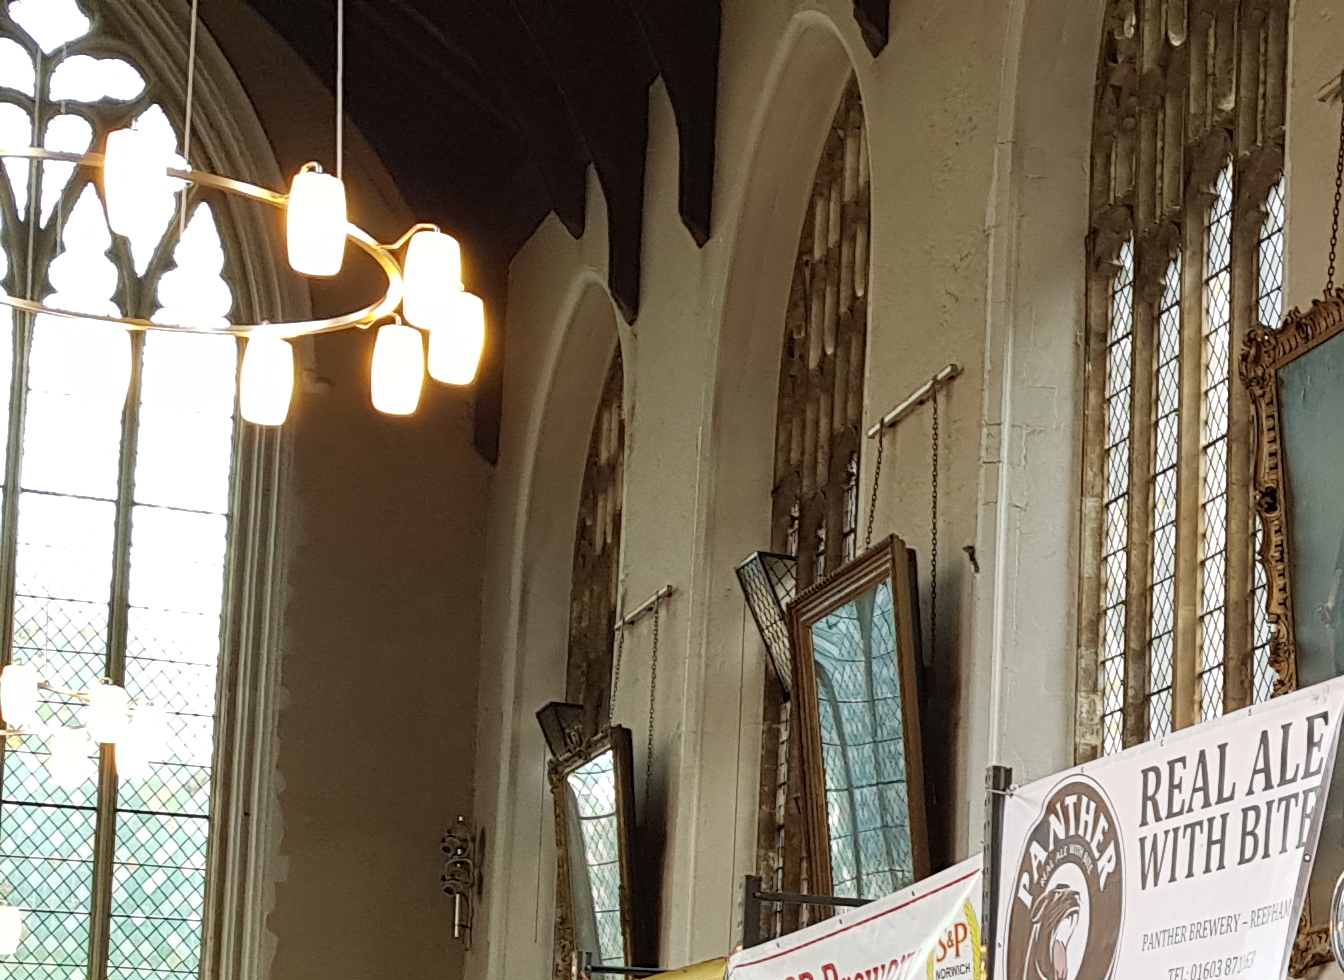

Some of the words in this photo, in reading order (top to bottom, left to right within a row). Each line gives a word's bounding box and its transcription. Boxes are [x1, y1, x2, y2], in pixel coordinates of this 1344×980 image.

[1139, 743, 1236, 828] REAL
[1245, 711, 1330, 797] ALE
[1018, 794, 1116, 909] PANTHER
[1139, 812, 1230, 891] WITH
[1237, 787, 1319, 867] BITE
[937, 923, 967, 962] S&P
[1142, 928, 1186, 951] PANTHER
[1190, 914, 1240, 944] BREWERY
[1250, 899, 1292, 929] REEPHAM
[936, 963, 970, 980] NORWICH
[1190, 959, 1222, 980] 01603
